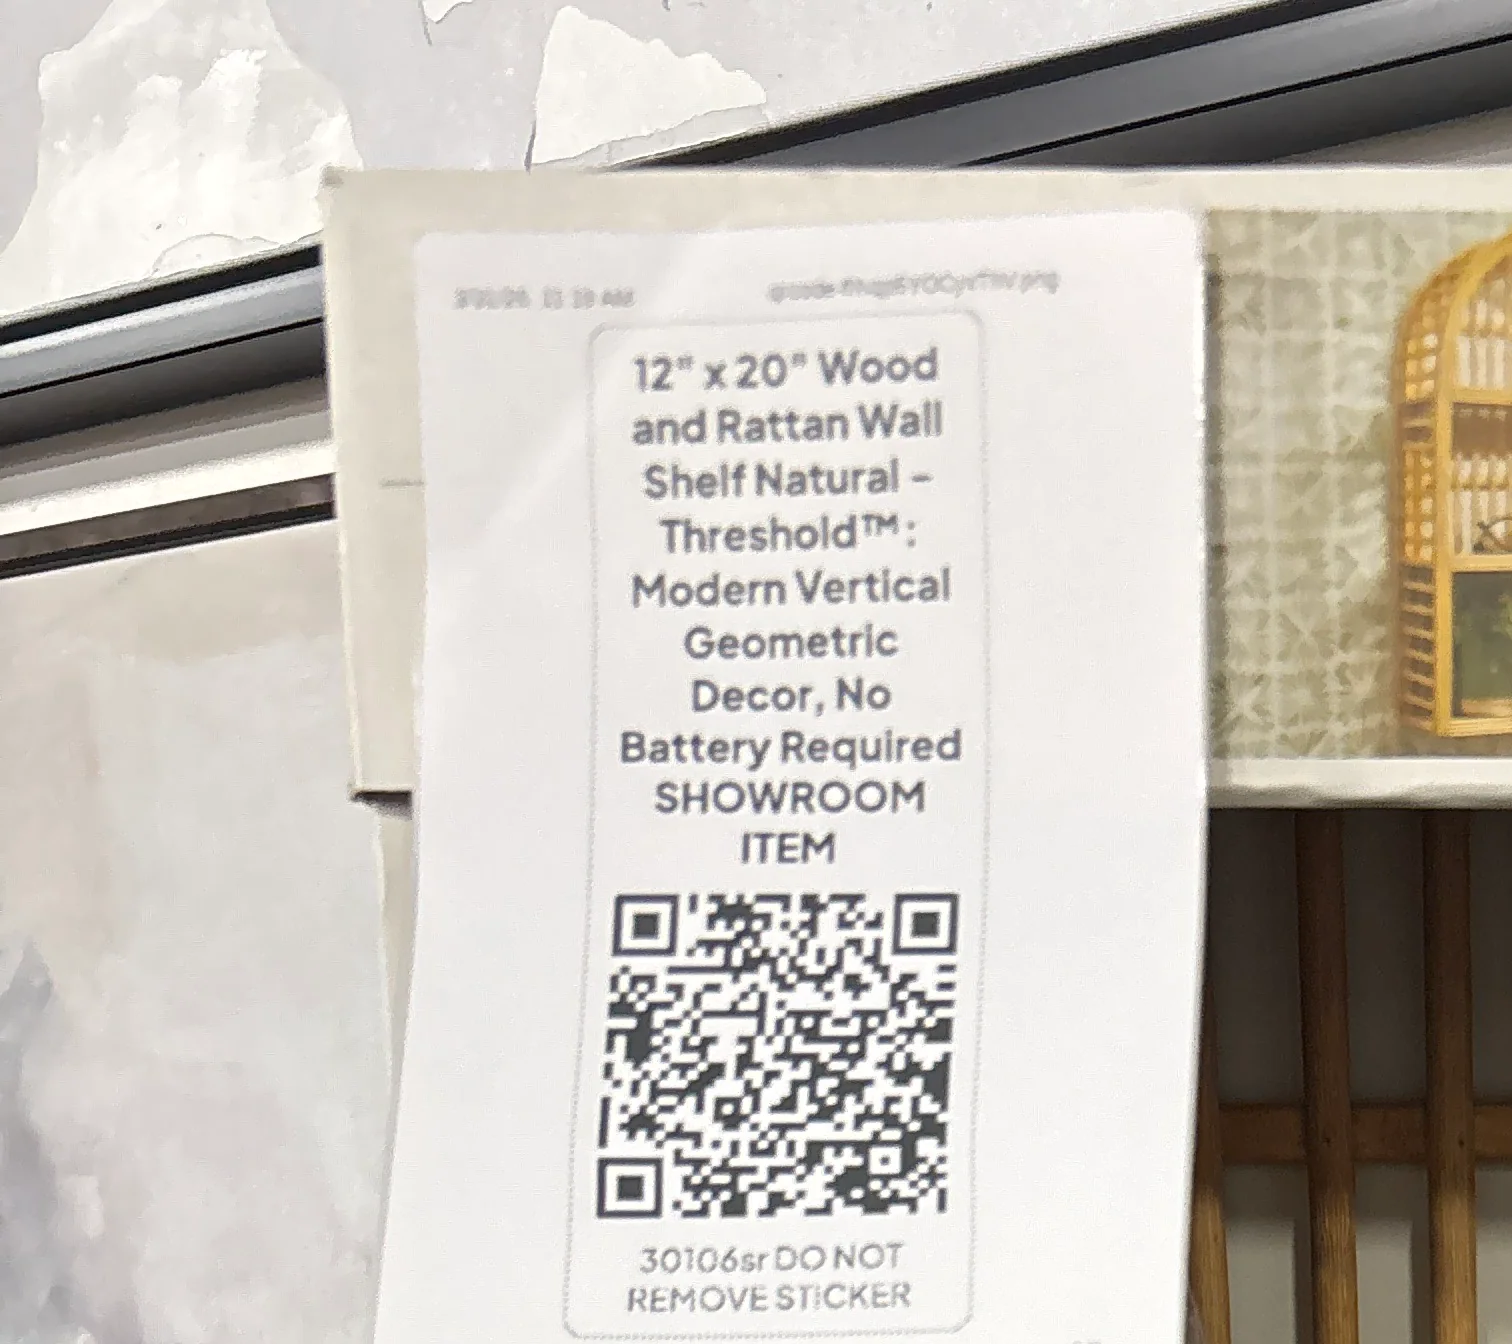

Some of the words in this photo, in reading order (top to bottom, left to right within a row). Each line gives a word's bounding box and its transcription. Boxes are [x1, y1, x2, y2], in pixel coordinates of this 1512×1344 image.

[634, 356, 693, 392] 12"
[705, 364, 726, 389] x
[736, 352, 806, 389] 20"
[818, 347, 938, 385] Wood
[632, 408, 707, 445] and
[717, 408, 849, 443] Rattan
[857, 401, 942, 438] Wall
[644, 462, 746, 499] Shelf
[755, 458, 899, 496] Natural
[632, 573, 786, 608] Modern
[795, 567, 950, 604] Vertical
[684, 623, 898, 659] Geometric
[692, 679, 824, 716] Decor,
[837, 677, 891, 710] No
[621, 731, 771, 771] Battery
[781, 728, 961, 770] Required
[655, 780, 925, 814] SHOWROOM
[742, 832, 835, 863] ITEM
[640, 1247, 769, 1274] 30106sr
[775, 1245, 827, 1271] DO
[833, 1242, 903, 1269] NOT
[627, 1285, 768, 1313] REMOVE
[775, 1282, 911, 1311] STICKER
